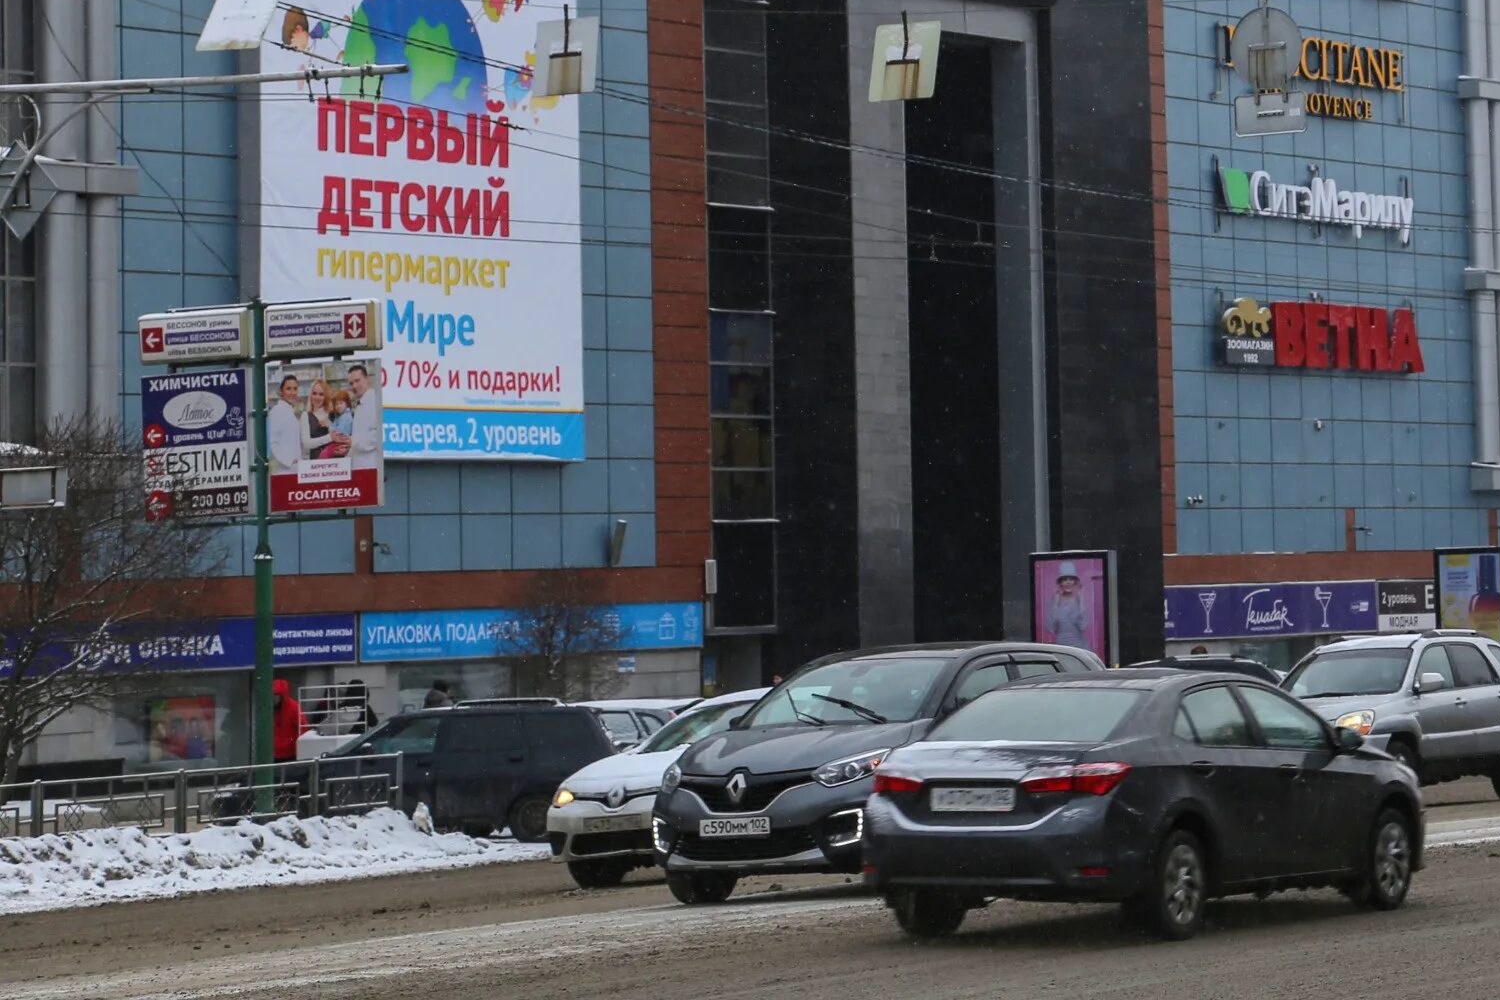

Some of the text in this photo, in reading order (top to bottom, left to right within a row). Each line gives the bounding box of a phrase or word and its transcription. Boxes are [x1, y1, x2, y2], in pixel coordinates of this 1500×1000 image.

[317, 98, 509, 168] ПЕРВЫЙ
[317, 176, 510, 237] ДЕТСКИЙ
[317, 248, 510, 296] гипермаркет
[166, 320, 207, 330] БЕССОНОВ
[305, 324, 341, 334] ОКТЯБРЯ
[387, 300, 475, 356] Мире
[190, 331, 236, 342] БЕССОНОВА
[1227, 339, 1273, 351] ЗООМАГАЗИН
[1272, 302, 1424, 373] ВЕТНА
[149, 373, 239, 392] ХИМЧИСТКА
[395, 360, 441, 389] 70%
[449, 369, 460, 390] и
[467, 366, 560, 398] подарки!
[173, 434, 204, 444] уровень
[467, 418, 478, 445] 2
[483, 424, 562, 451] уровень
[166, 447, 241, 475] ESTIMA
[192, 491, 248, 508] 200 09 09
[288, 487, 360, 501] ГОСАПТЕКА
[1381, 592, 1387, 605] 2
[1389, 615, 1418, 628] МОДНАЯ
[325, 628, 353, 637] линзы
[367, 623, 442, 645] УПАКОВКА
[332, 644, 353, 652] очки
